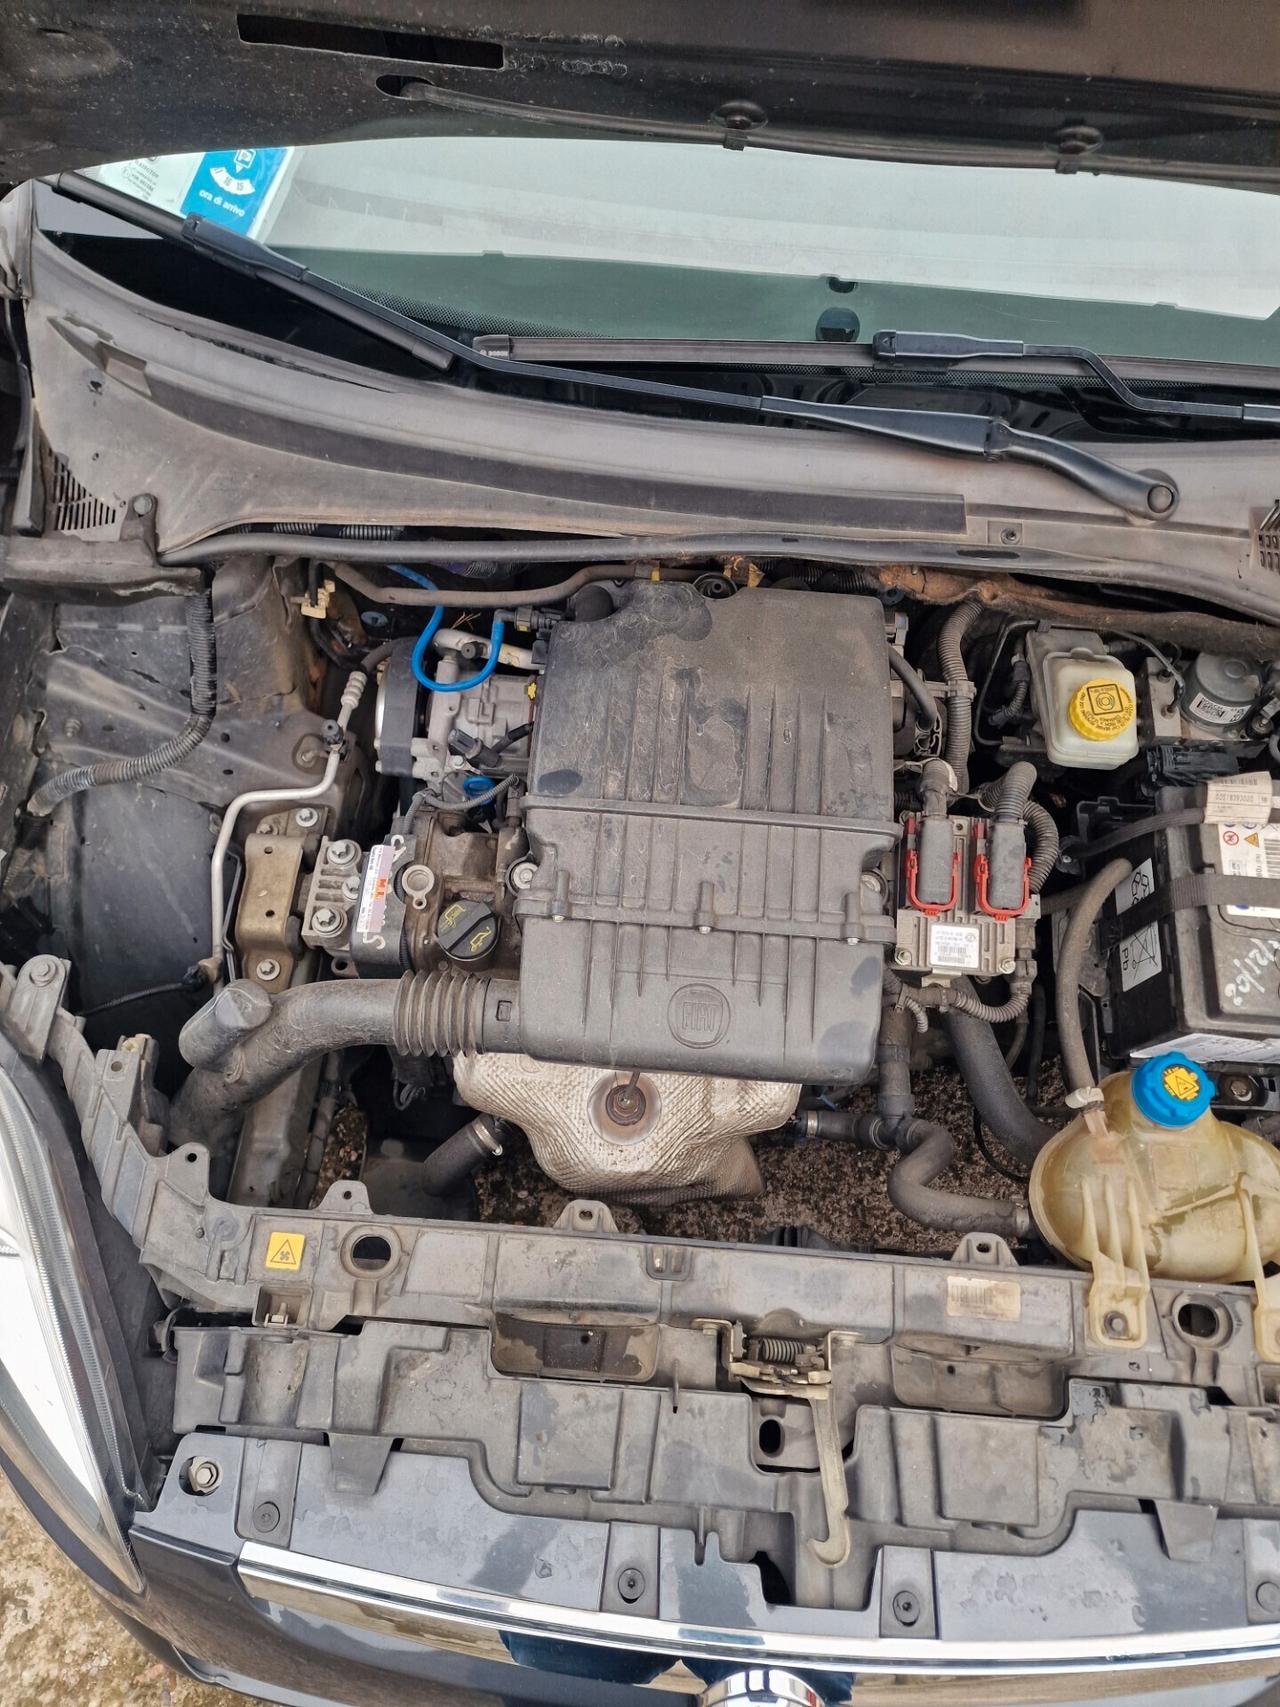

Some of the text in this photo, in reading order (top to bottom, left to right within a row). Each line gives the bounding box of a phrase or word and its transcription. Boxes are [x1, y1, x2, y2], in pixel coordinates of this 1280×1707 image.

[199, 189, 245, 217] ora di arrivo
[1122, 947, 1130, 971] Pb
